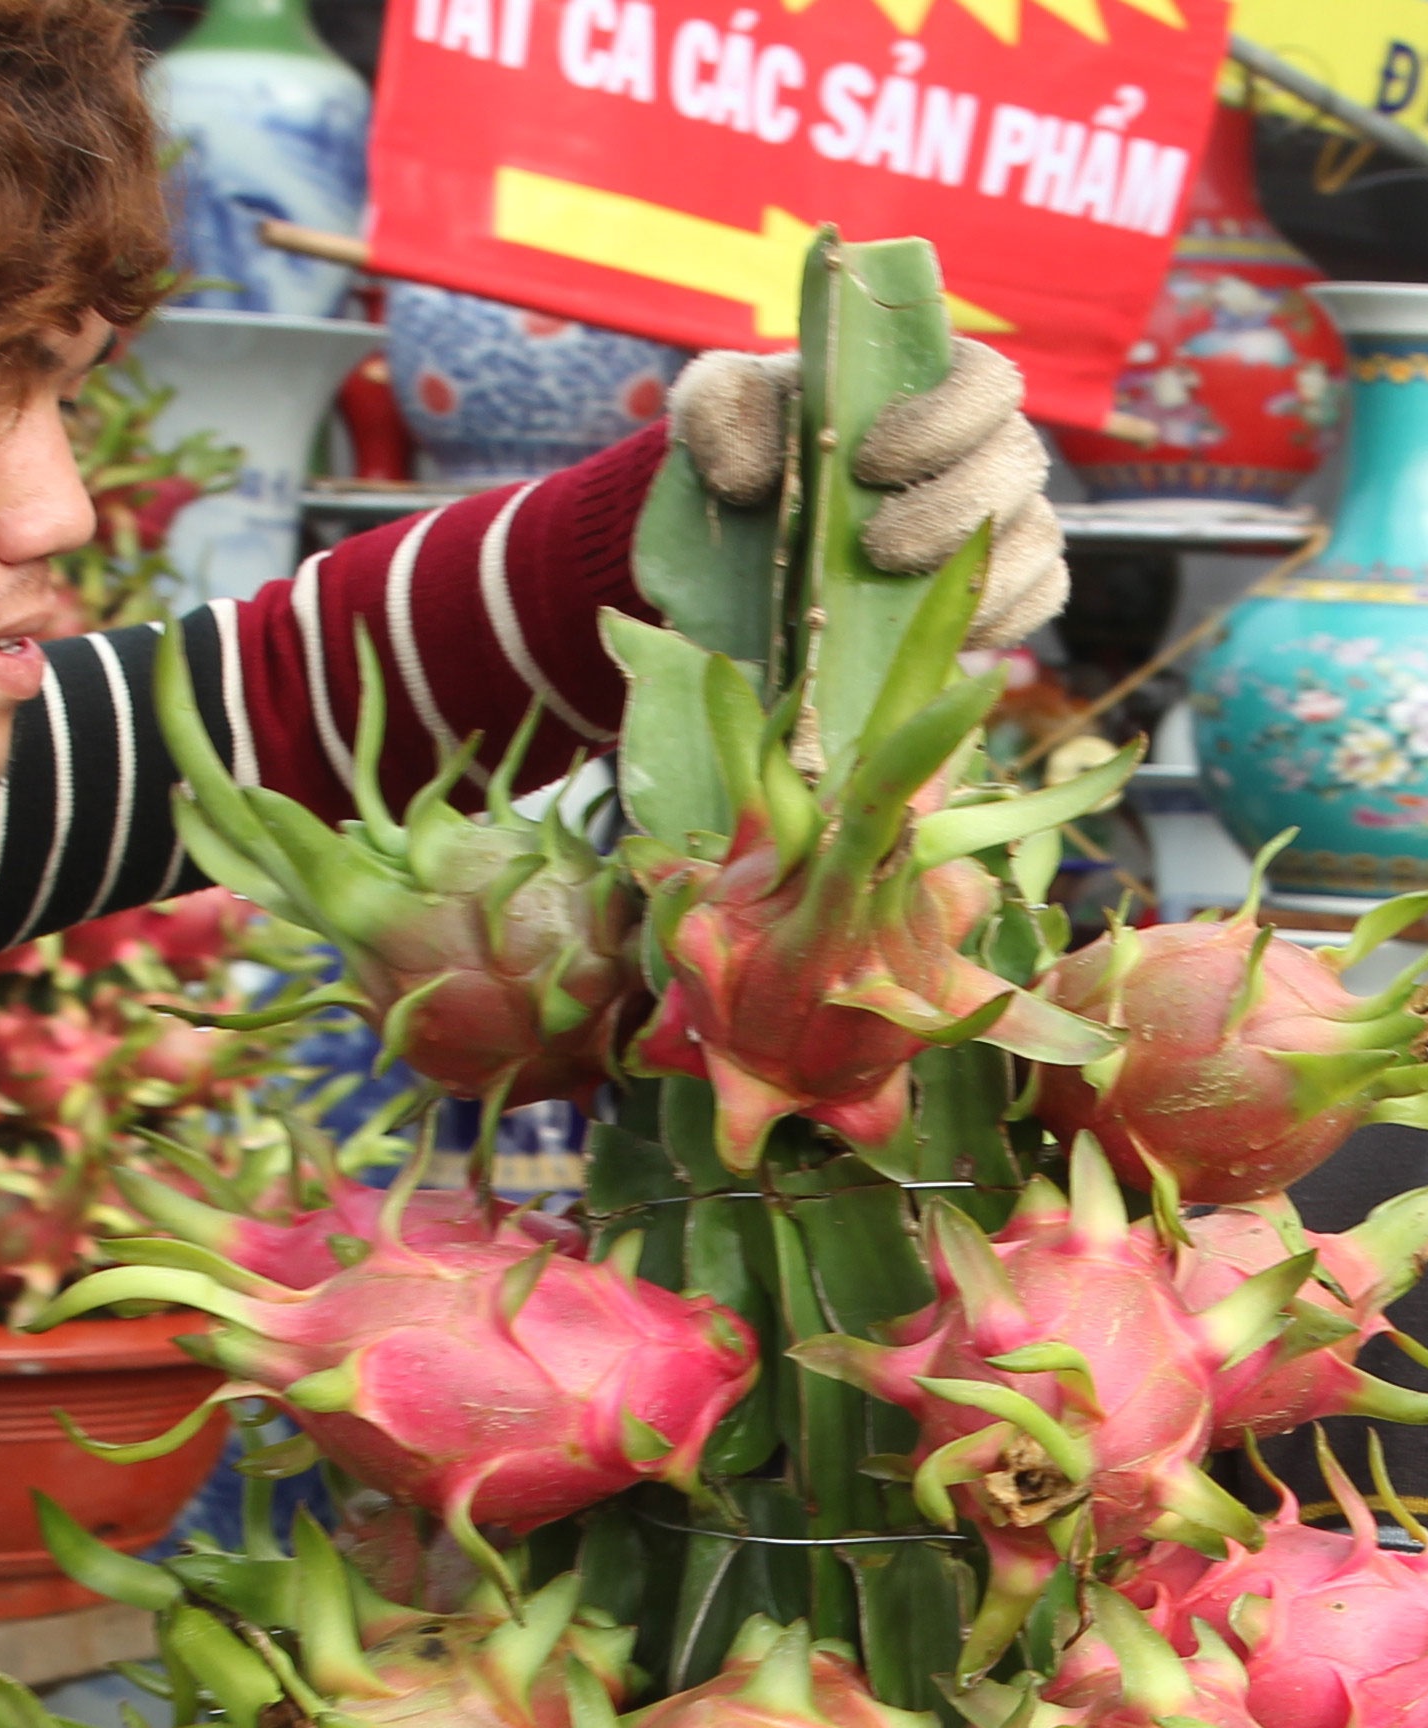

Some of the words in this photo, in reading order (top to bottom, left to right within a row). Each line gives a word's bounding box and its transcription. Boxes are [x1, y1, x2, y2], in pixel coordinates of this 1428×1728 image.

[670, 8, 806, 144] CÁC
[808, 39, 979, 187] SẢN
[978, 84, 1190, 238] PHẨM
